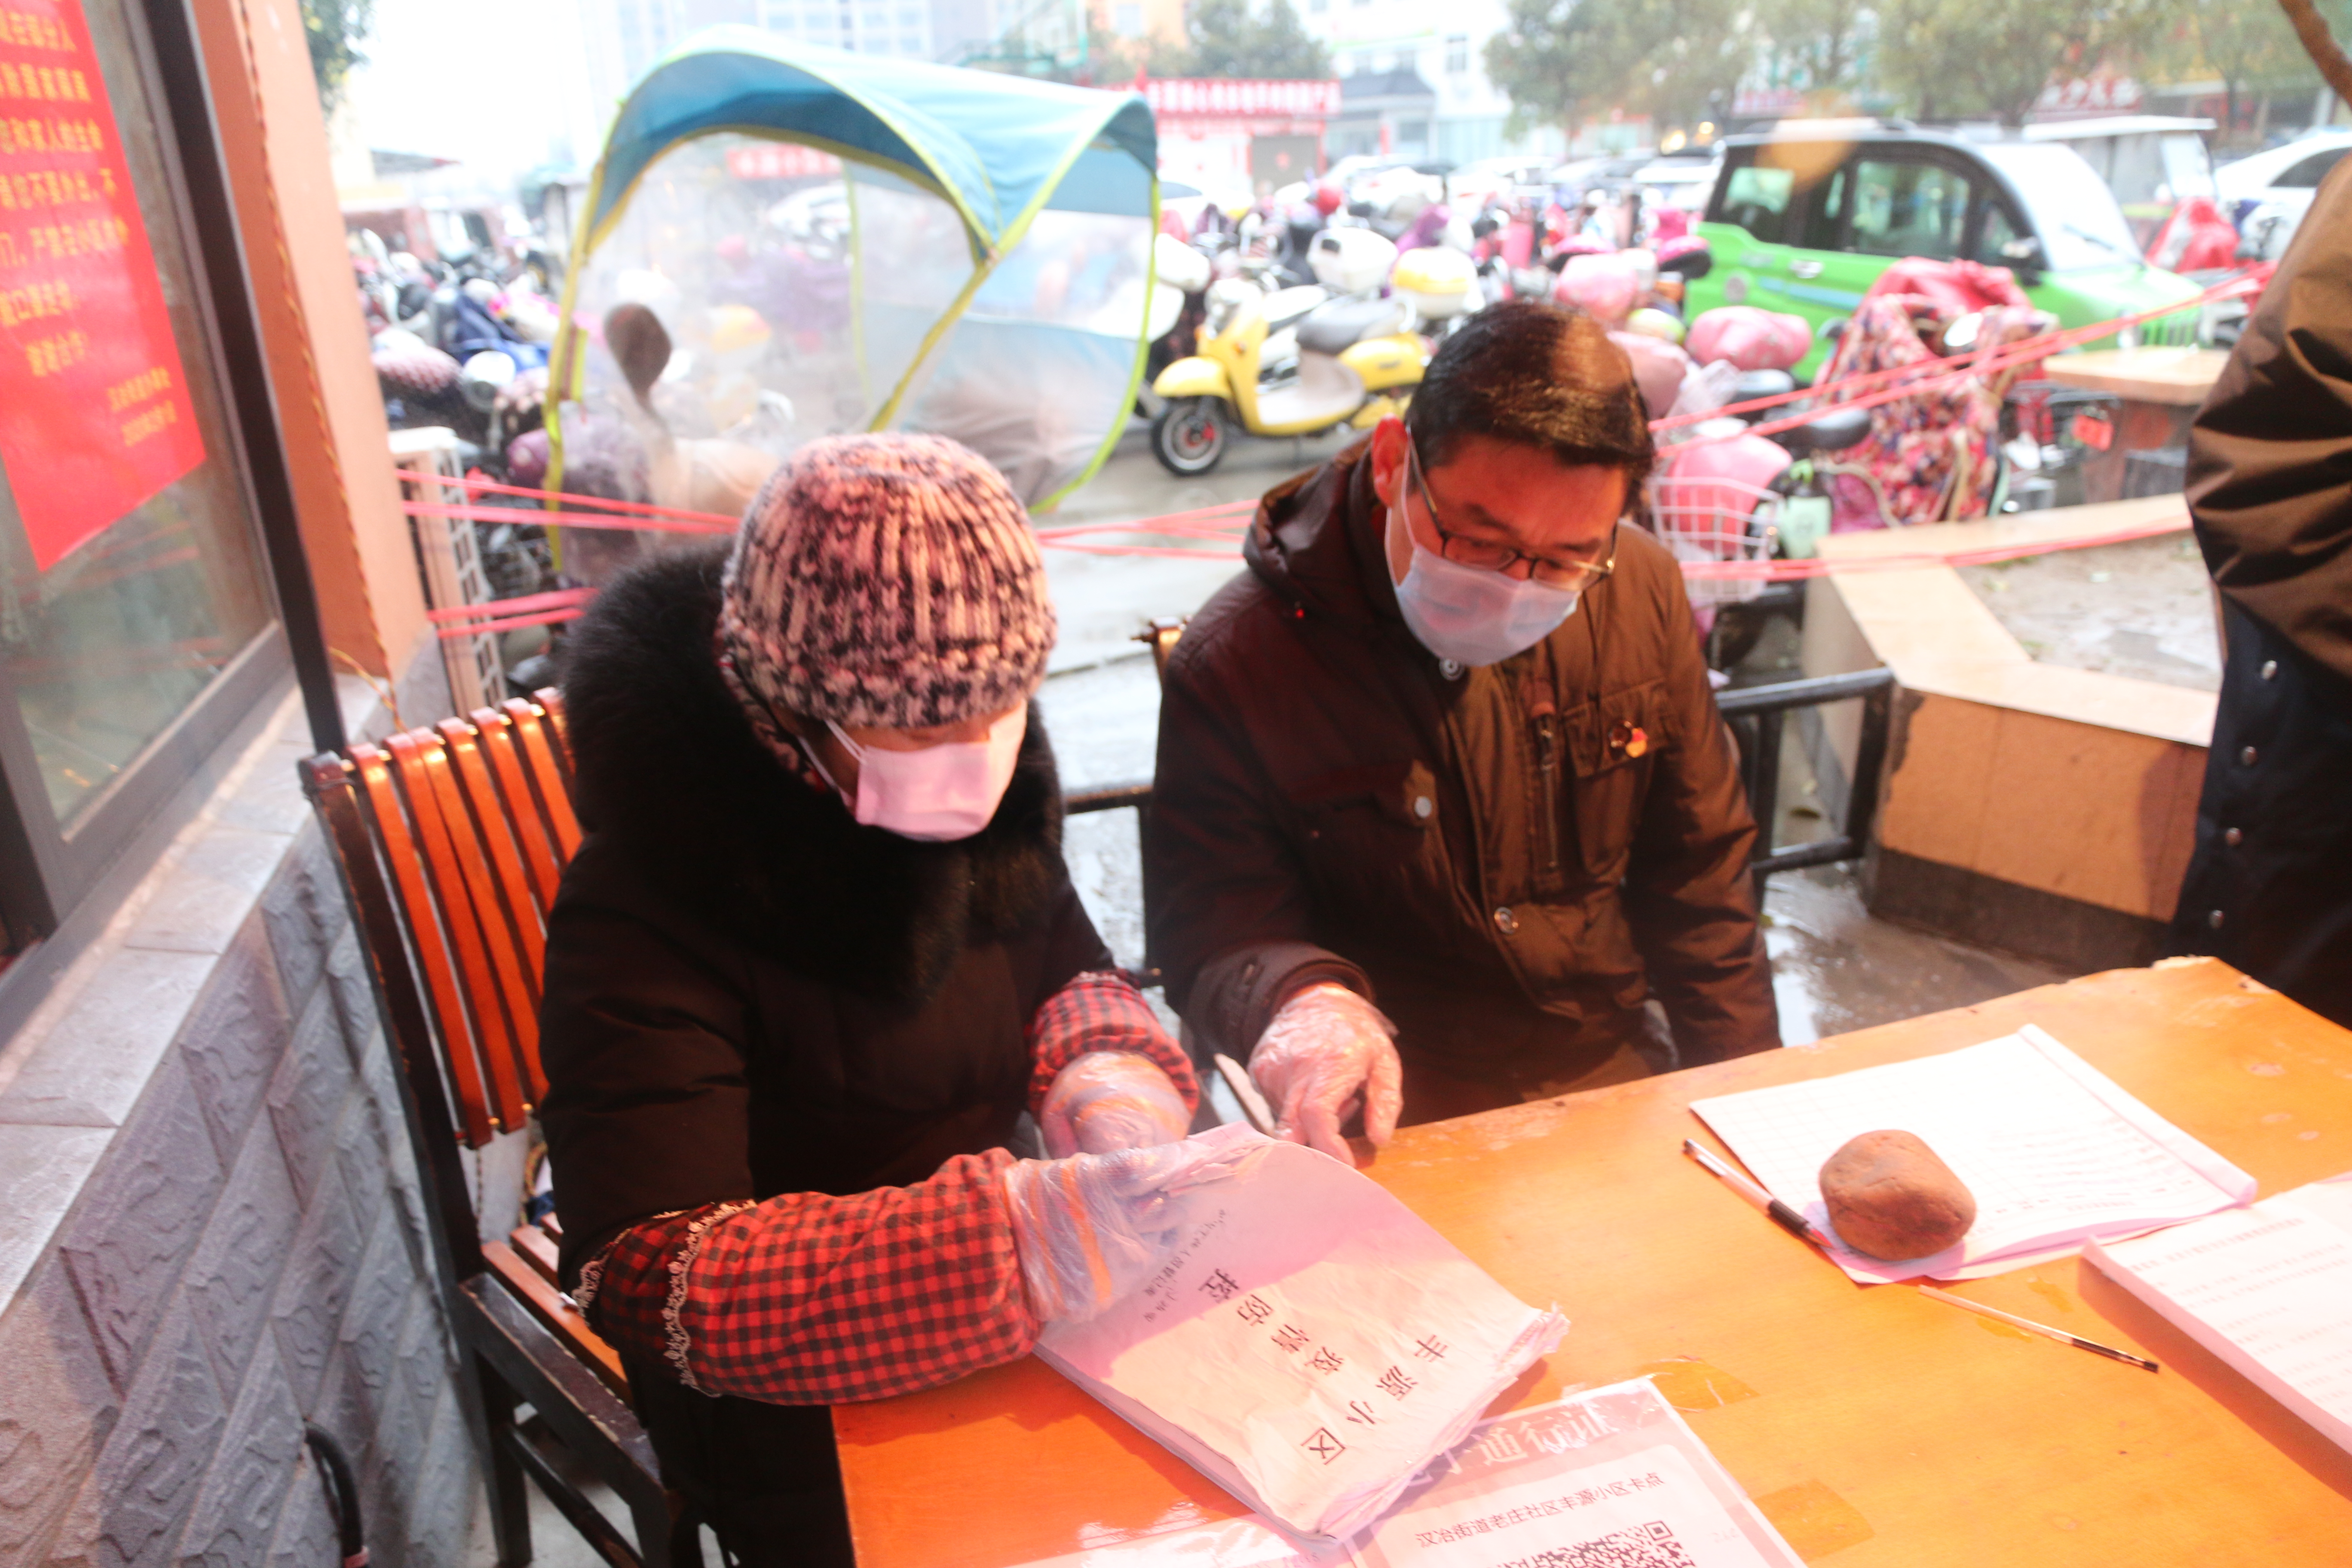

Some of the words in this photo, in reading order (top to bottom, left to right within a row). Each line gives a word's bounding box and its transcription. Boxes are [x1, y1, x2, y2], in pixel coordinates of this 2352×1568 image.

[1198, 1268, 1344, 1378] 疫情防控
[1301, 1334, 1449, 1465] 丰源小区
[1415, 1472, 1665, 1548] 汉冶街道老庄社区丰源小区卡点
